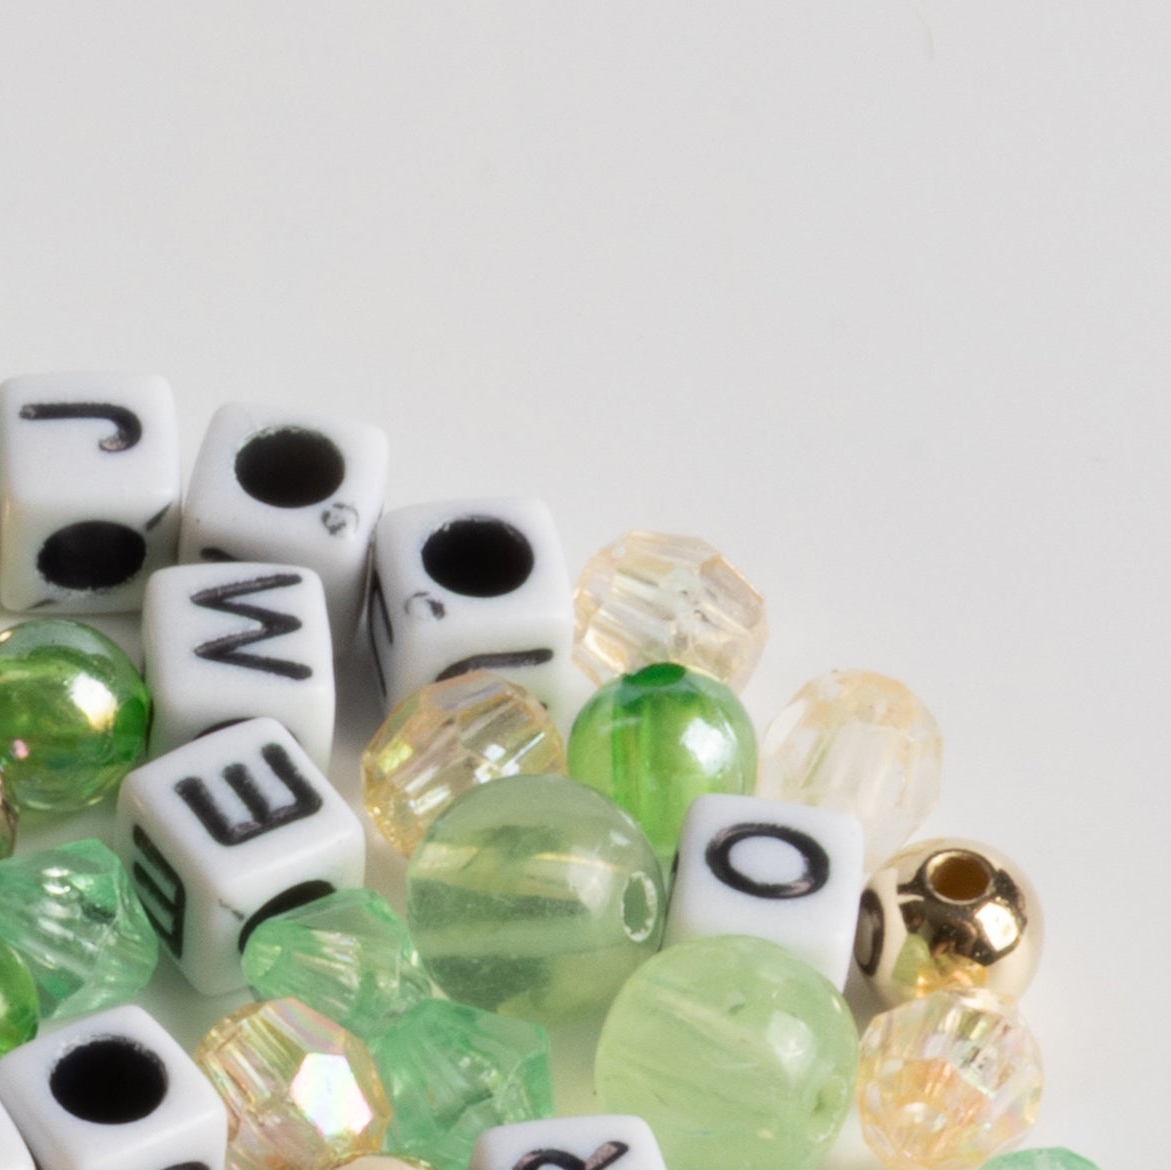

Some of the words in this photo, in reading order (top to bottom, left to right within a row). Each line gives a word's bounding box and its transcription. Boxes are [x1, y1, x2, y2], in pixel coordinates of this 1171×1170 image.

[19, 402, 142, 452] J
[174, 743, 323, 847] E
[704, 823, 830, 900] O
